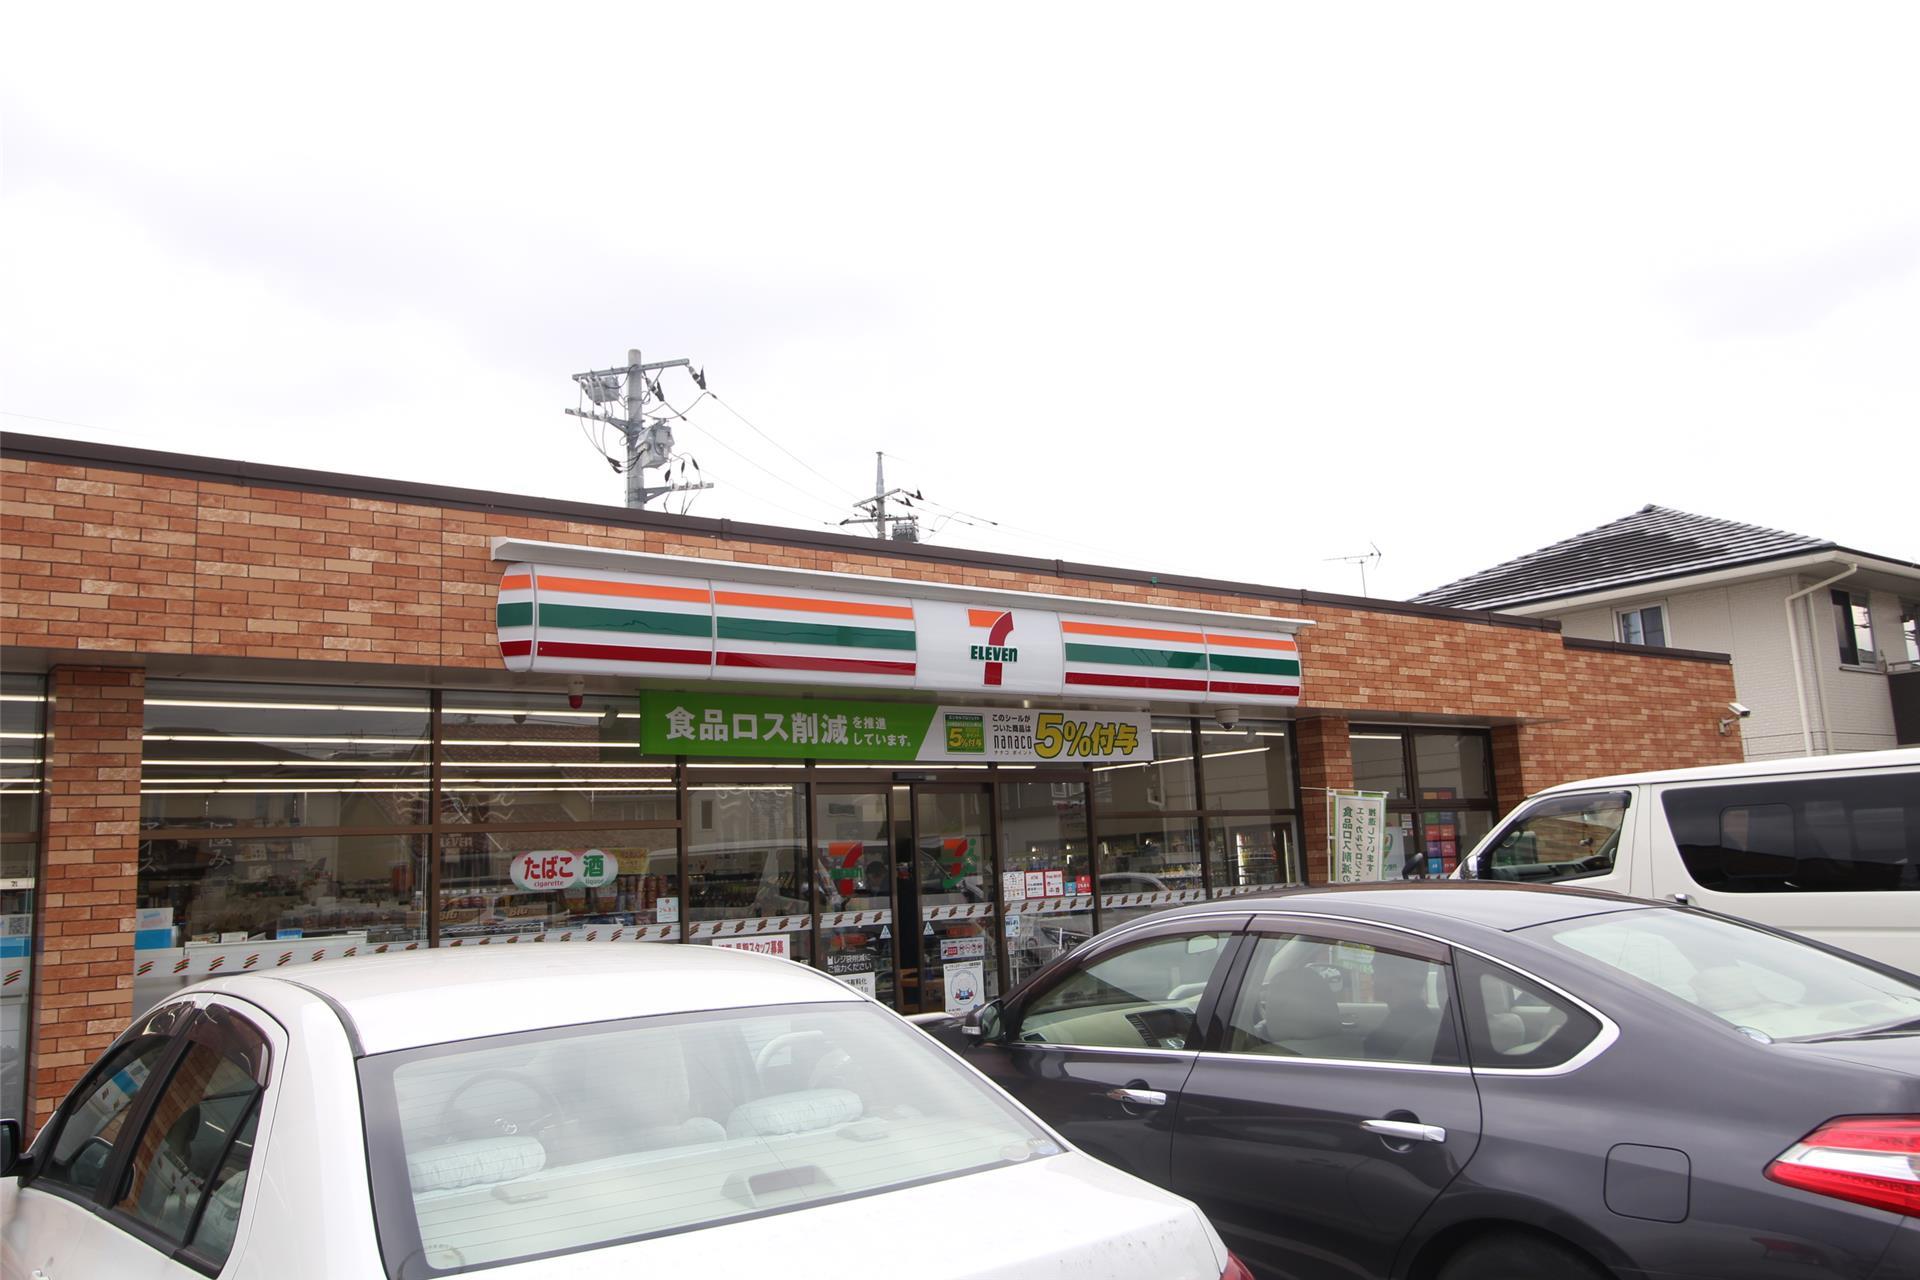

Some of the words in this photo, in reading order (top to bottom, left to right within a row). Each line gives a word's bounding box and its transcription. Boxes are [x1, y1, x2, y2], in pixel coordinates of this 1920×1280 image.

[852, 716, 887, 730] を推進
[992, 713, 1031, 722] このシールが
[665, 705, 849, 745] 食品ロス削減
[992, 724, 1031, 733] ついた商品は
[853, 732, 911, 747] しています。
[993, 735, 1033, 749] nanaco
[1033, 712, 1139, 759] 5%付与
[524, 855, 574, 880] たばこ
[583, 854, 604, 878] 酒
[534, 879, 564, 888] cigarette
